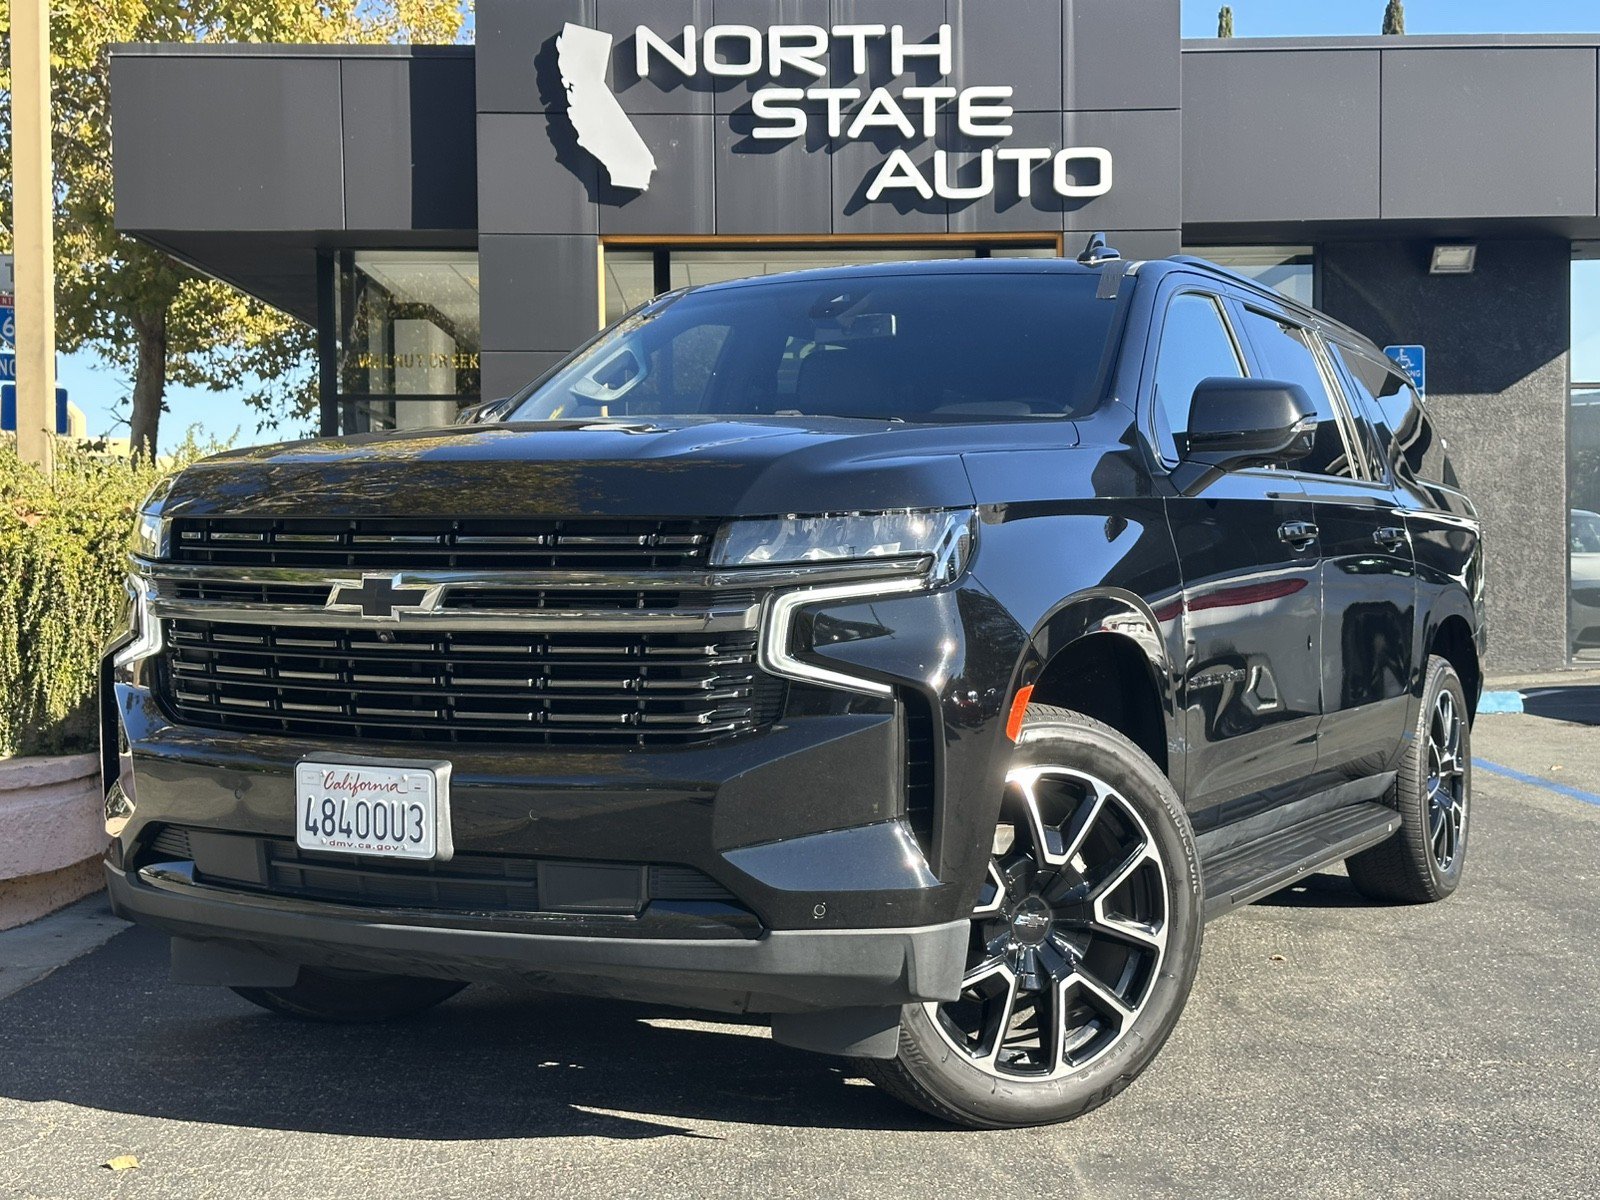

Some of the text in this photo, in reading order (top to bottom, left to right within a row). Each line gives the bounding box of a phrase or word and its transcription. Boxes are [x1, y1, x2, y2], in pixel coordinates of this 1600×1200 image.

[635, 24, 952, 77] NORTH
[751, 85, 1014, 140] STATE
[866, 147, 1113, 201] AUTO
[358, 352, 479, 369] WALNUT CREEK
[323, 770, 408, 798] California
[329, 839, 399, 851] dmv.ca.gov
